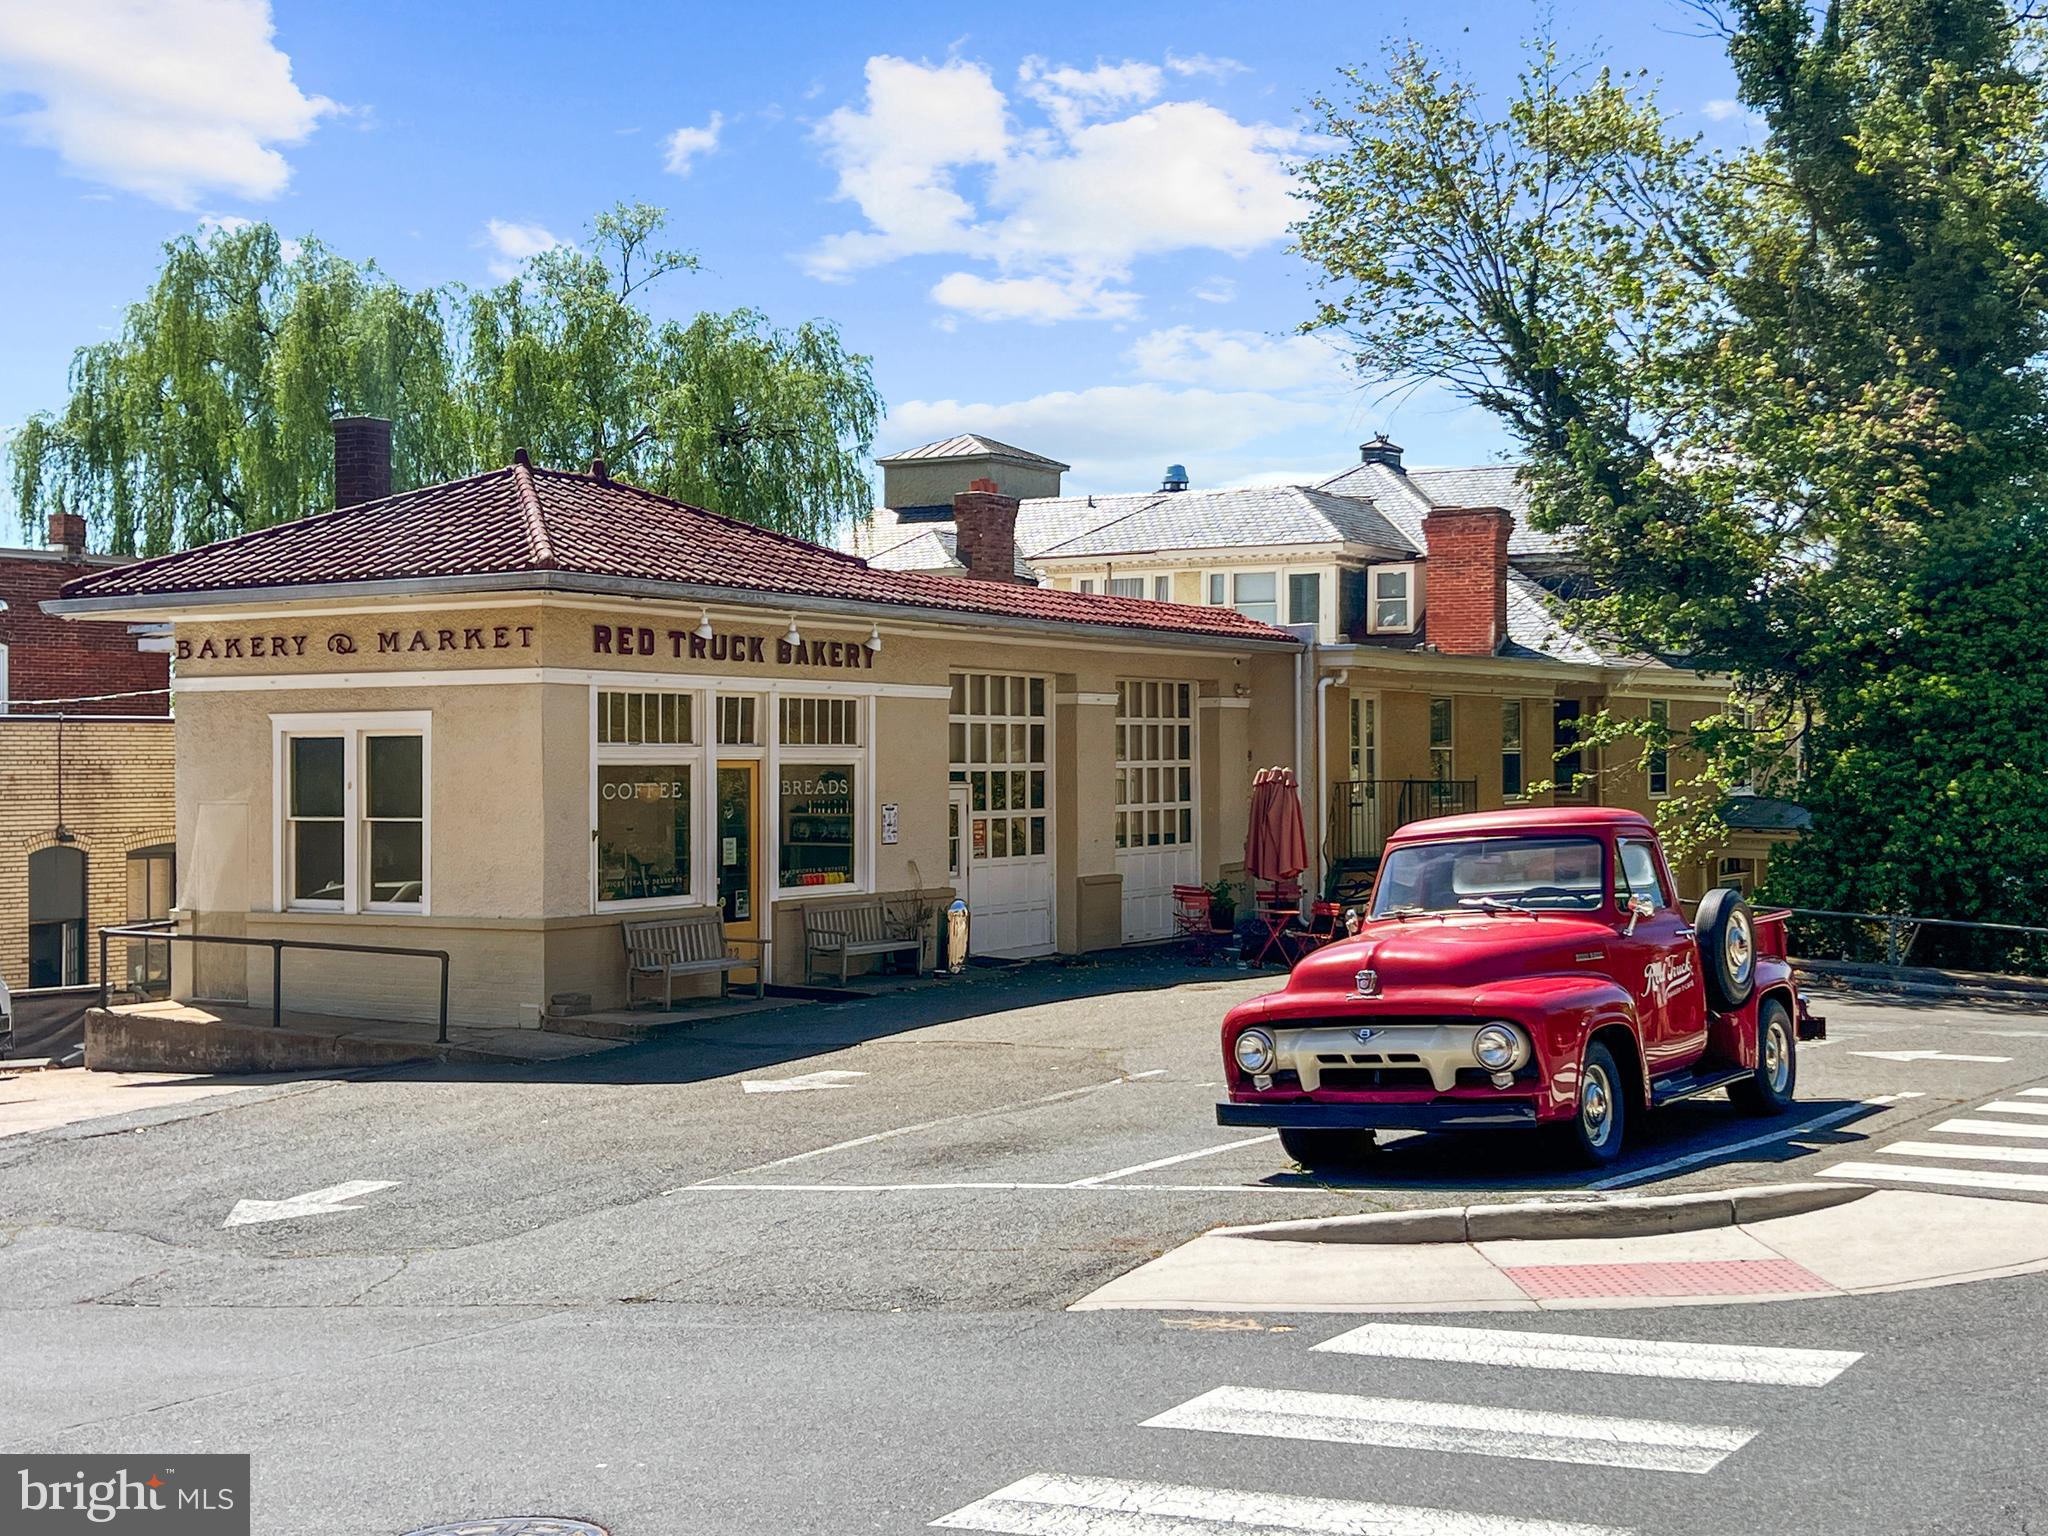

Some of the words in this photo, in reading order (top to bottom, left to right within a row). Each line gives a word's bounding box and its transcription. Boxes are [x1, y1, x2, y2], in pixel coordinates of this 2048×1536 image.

[176, 636, 307, 660] BAKERY
[376, 626, 534, 653] MARKET
[593, 625, 655, 655] RED
[667, 630, 765, 663] TRUCK
[776, 637, 880, 669] BAKERY
[602, 782, 682, 800] COFFEE
[781, 780, 848, 795] BREADS
[1664, 951, 1694, 981] Truck
